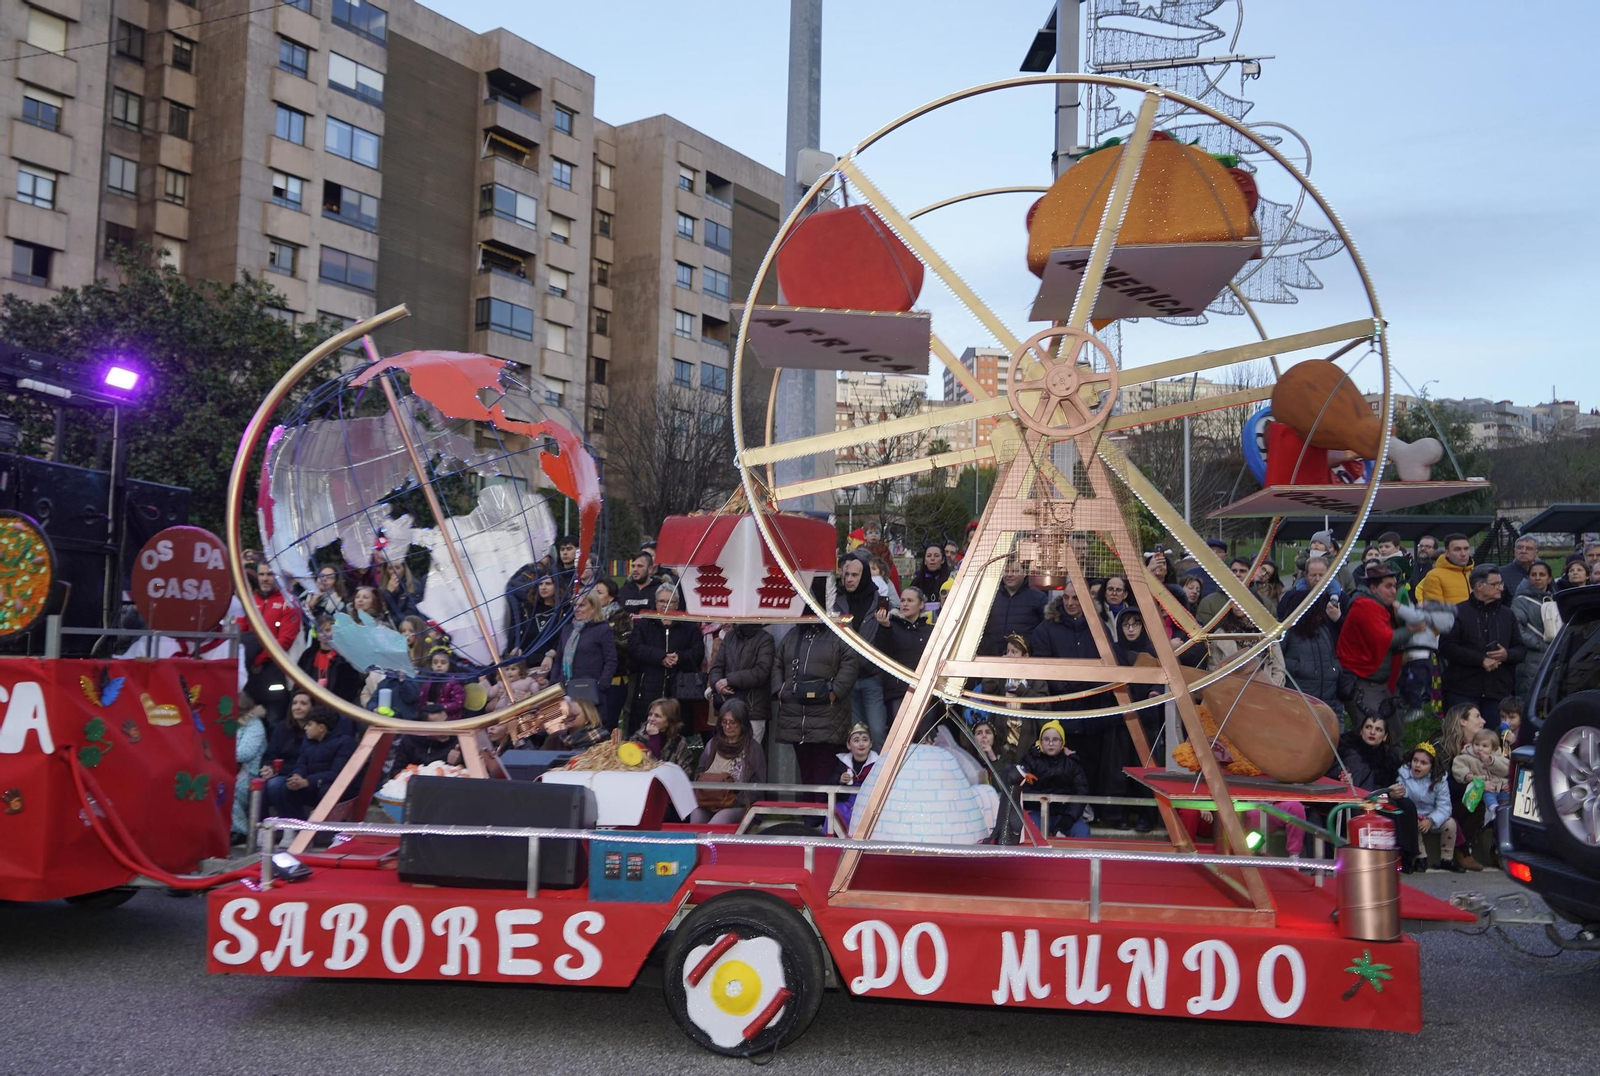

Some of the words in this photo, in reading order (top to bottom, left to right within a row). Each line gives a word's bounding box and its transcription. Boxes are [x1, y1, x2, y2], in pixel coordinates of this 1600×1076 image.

[751, 317, 916, 373] AFRICA
[140, 539, 174, 571] OS
[193, 541, 226, 571] DA
[147, 577, 216, 601] CASA
[0, 681, 56, 755] A
[212, 897, 606, 981] SABORES
[842, 919, 949, 996] DO
[992, 928, 1307, 1019] MUNDO
